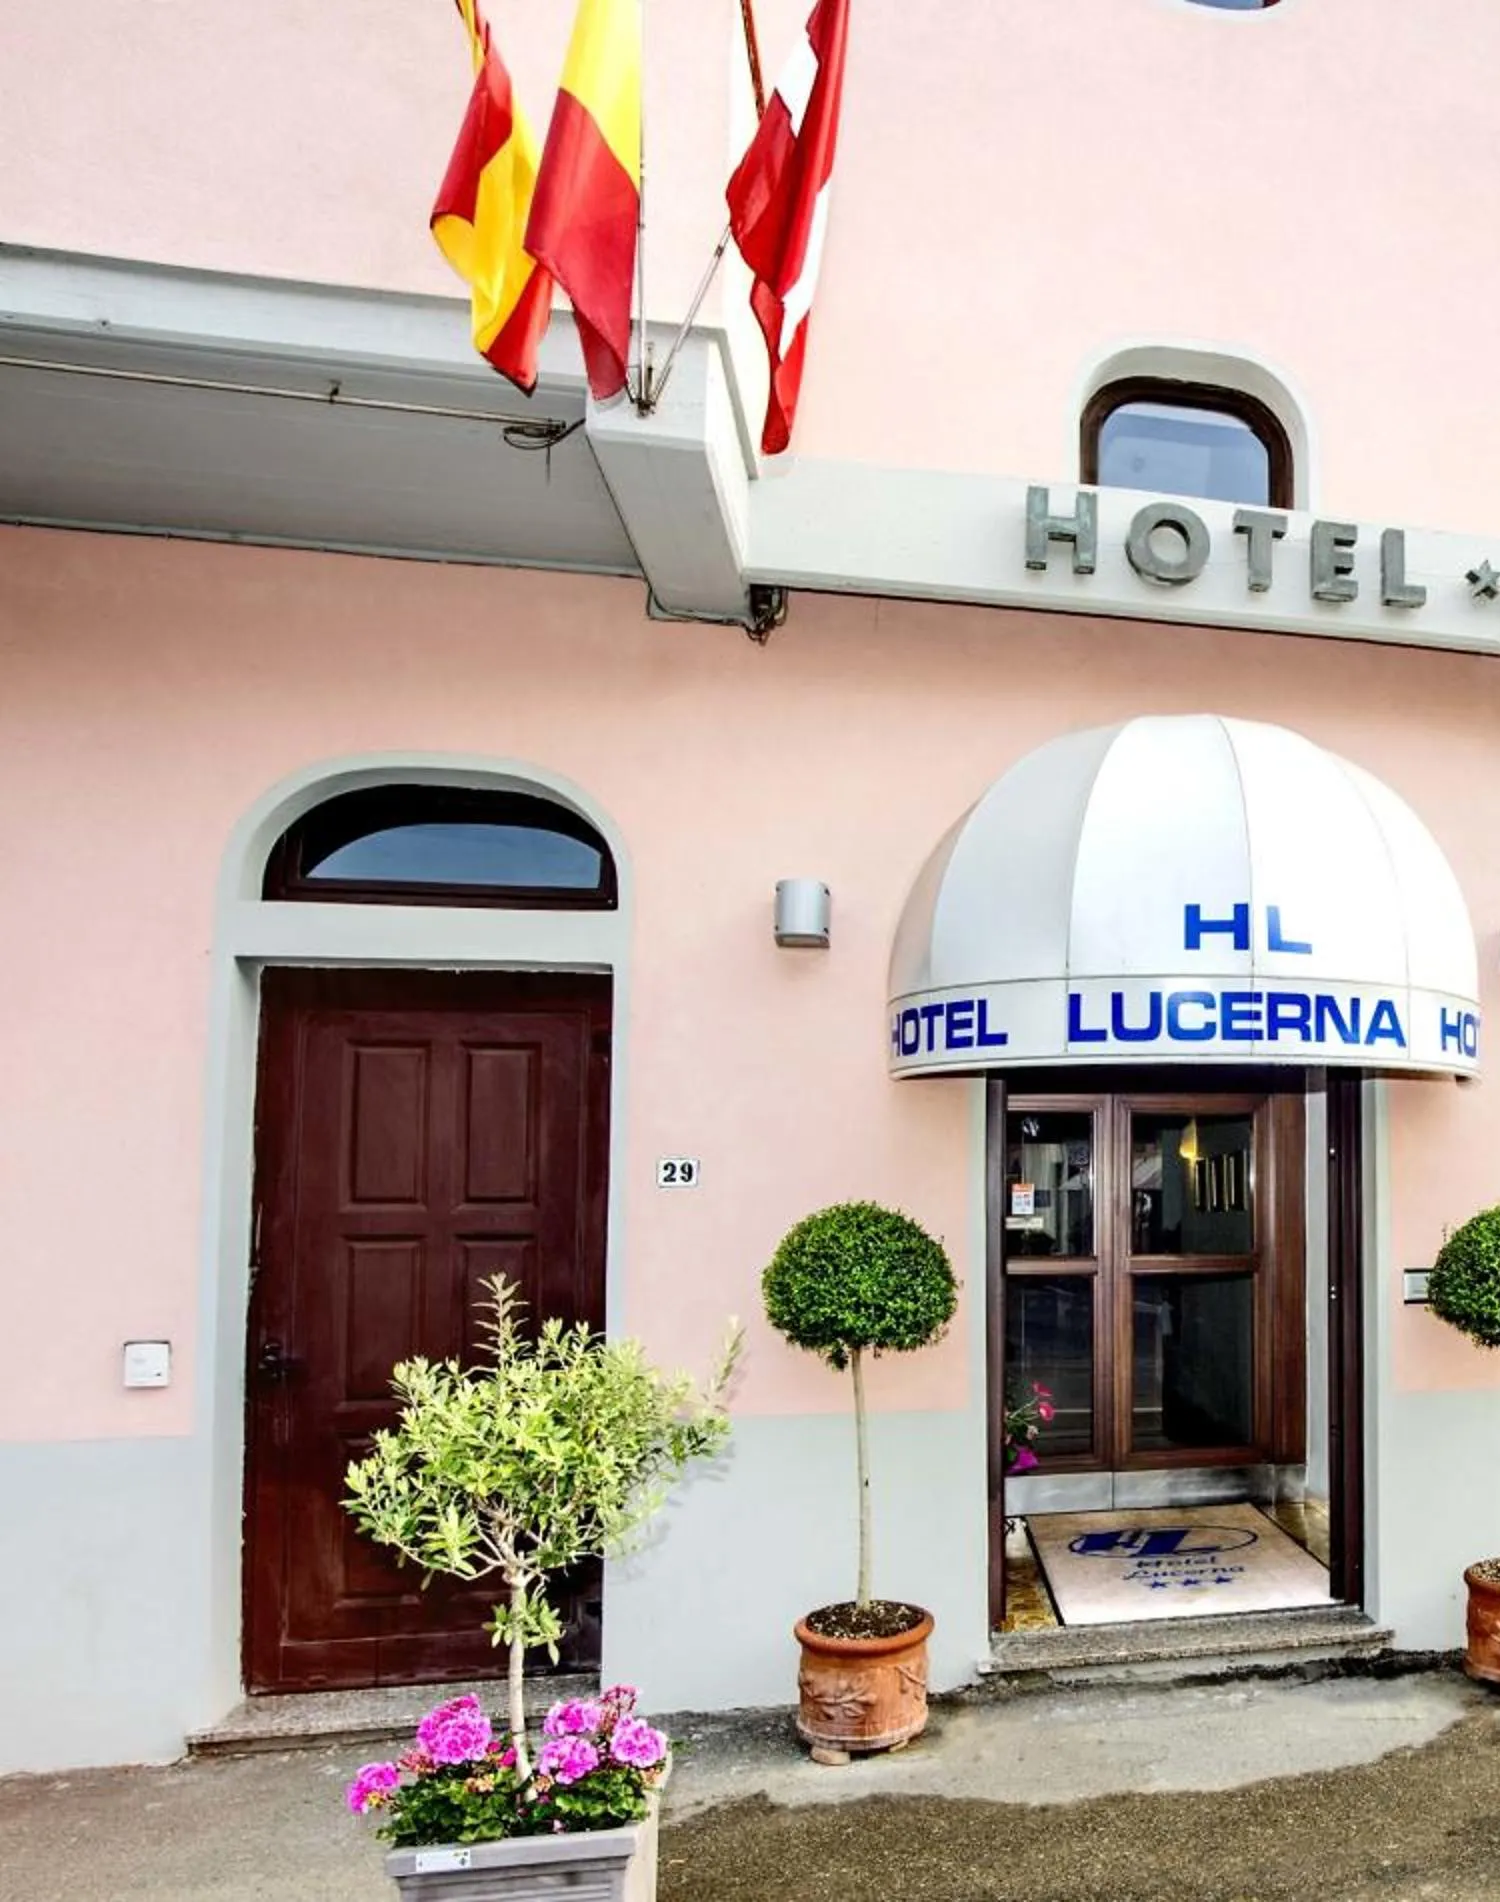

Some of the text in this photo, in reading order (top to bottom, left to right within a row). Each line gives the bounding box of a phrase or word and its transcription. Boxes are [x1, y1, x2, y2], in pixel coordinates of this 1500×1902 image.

[1025, 485, 1427, 609] HOTEL
[1068, 991, 1407, 1049] LUCERNA
[1441, 1007, 1481, 1058] HO
[663, 1161, 693, 1182] 29
